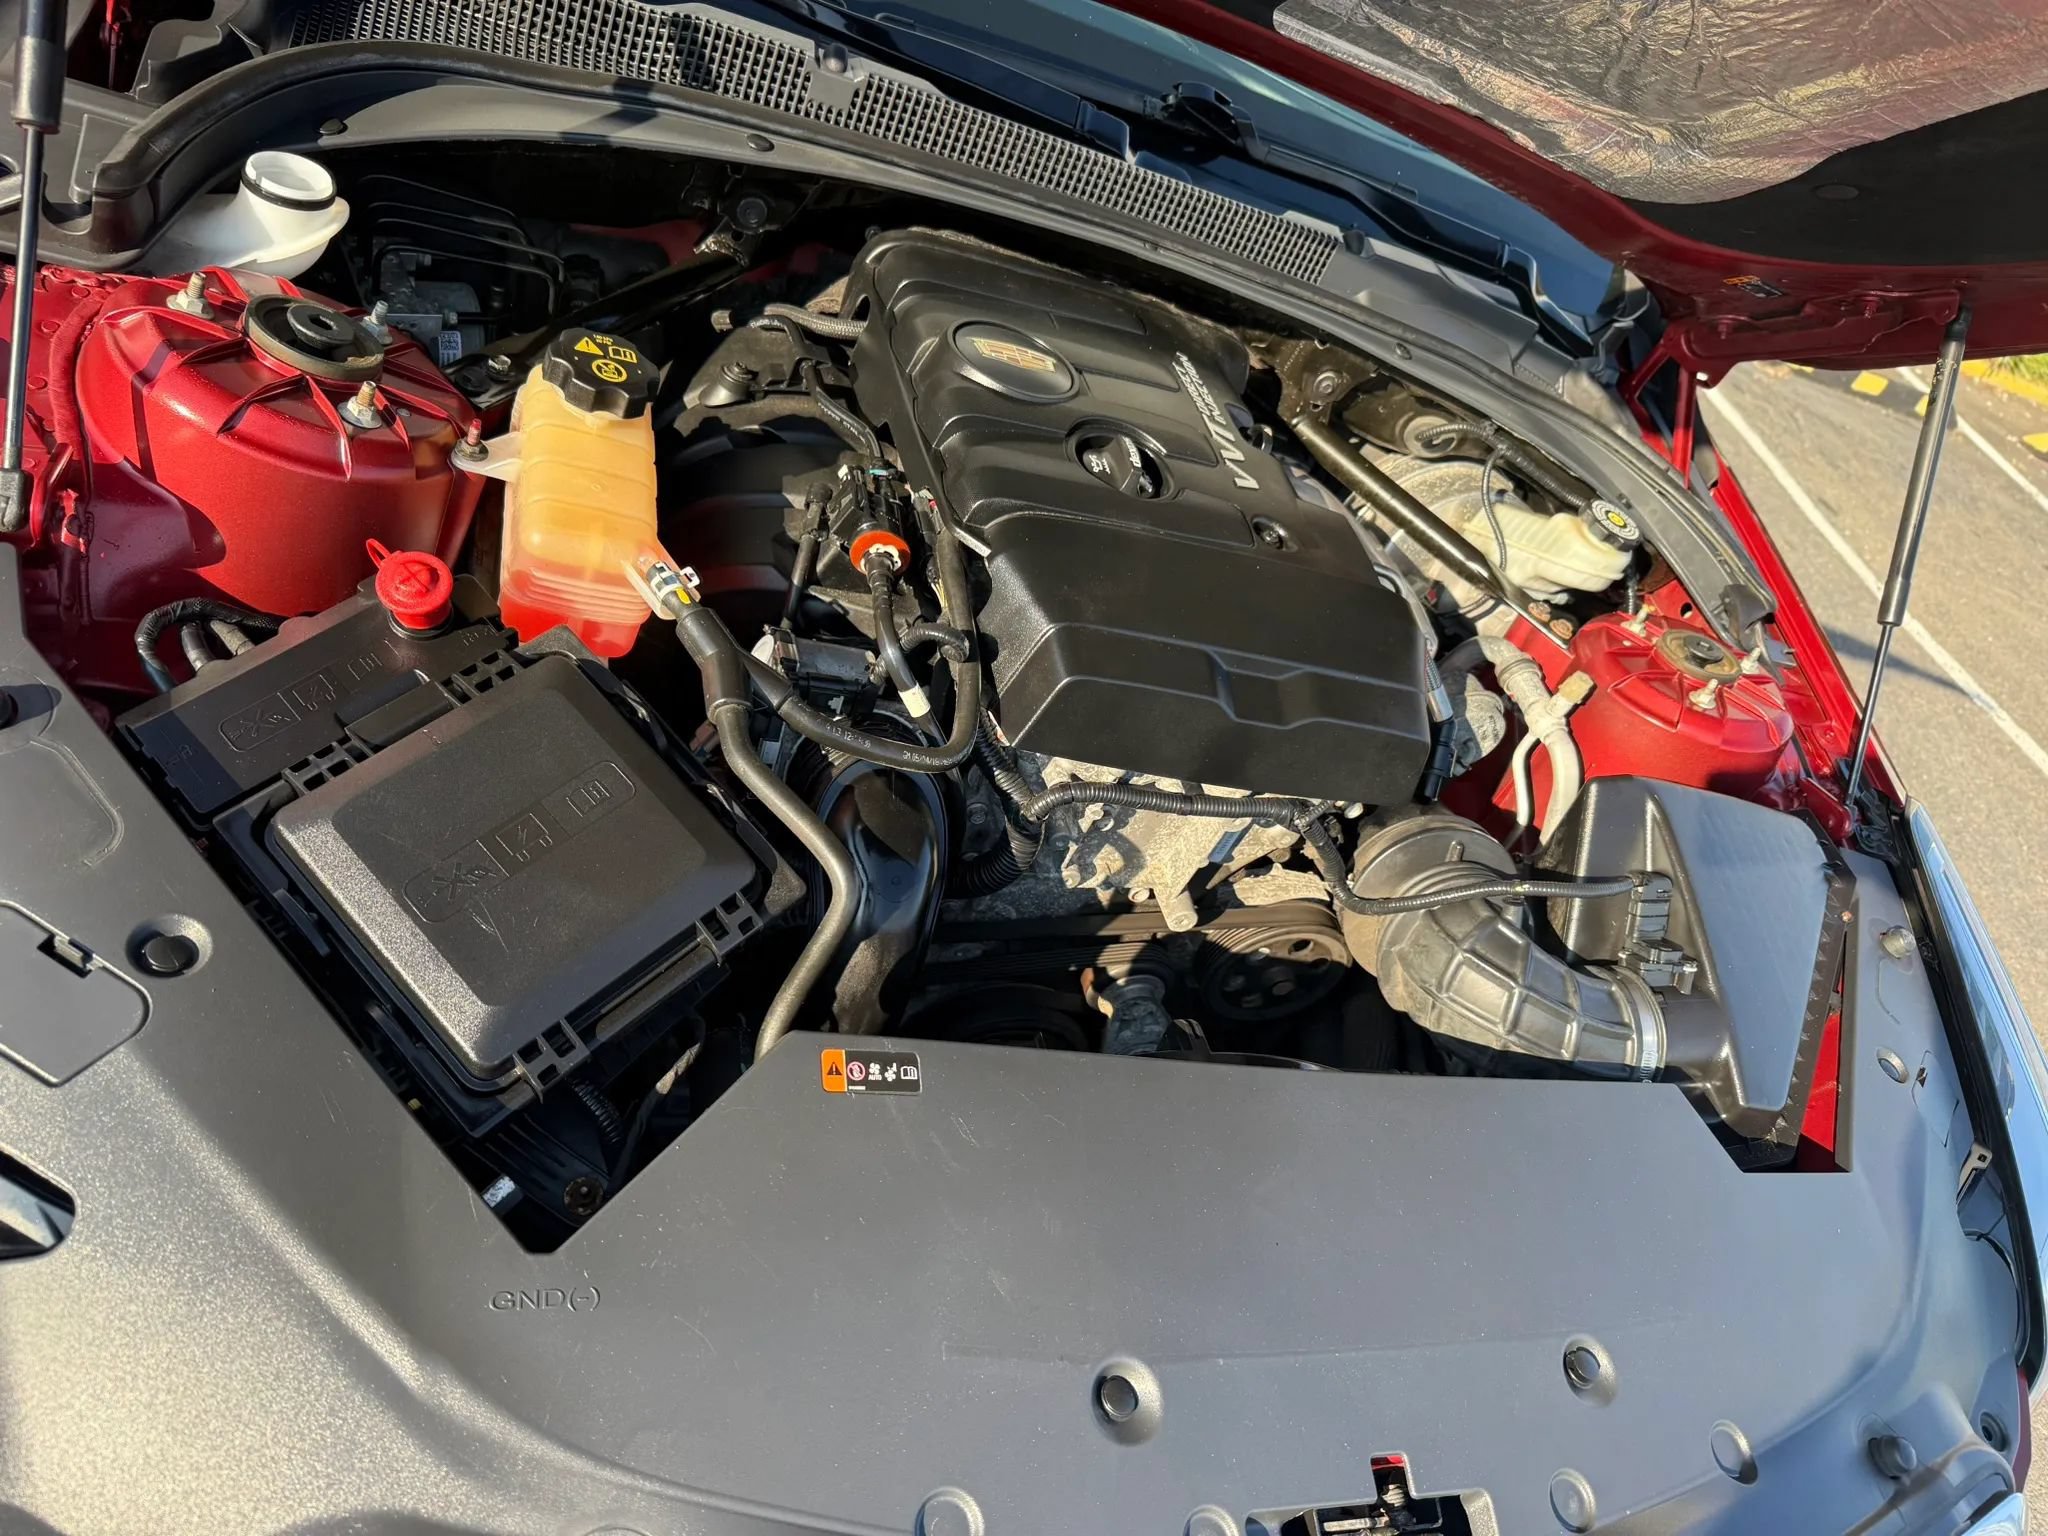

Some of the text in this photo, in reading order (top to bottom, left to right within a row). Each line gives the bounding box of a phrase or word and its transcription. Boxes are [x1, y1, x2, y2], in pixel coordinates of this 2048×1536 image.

[1172, 361, 1211, 416] DIRECT
[1176, 351, 1226, 425] INJECTION
[1202, 414, 1260, 489] VVT
[488, 1286, 600, 1312] GND(-)
